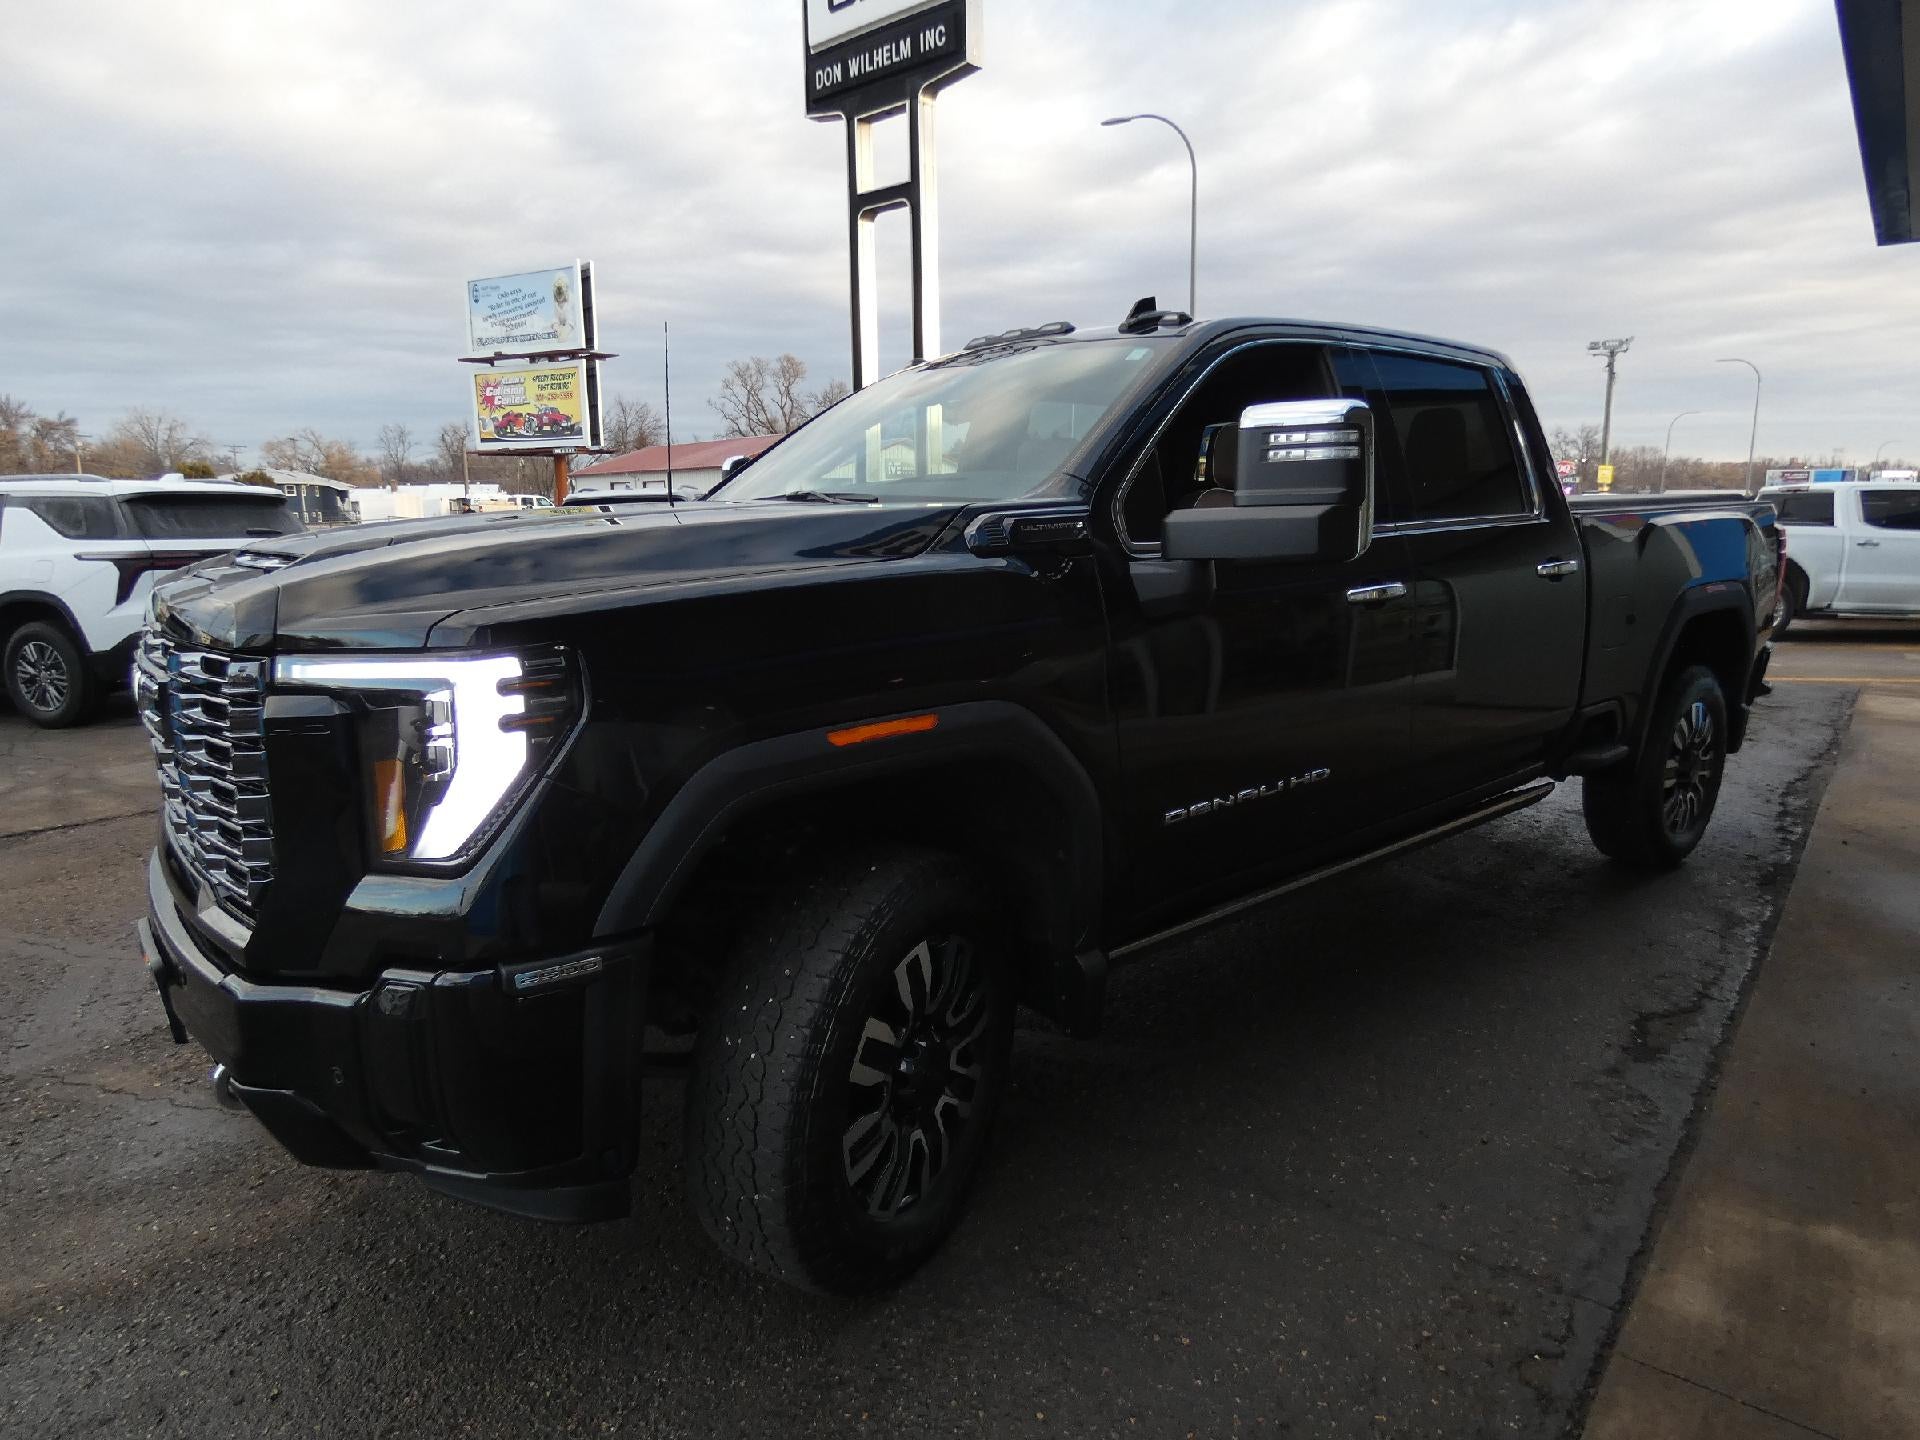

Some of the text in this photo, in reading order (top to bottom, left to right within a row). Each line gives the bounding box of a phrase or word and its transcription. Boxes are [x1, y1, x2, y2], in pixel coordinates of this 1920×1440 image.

[815, 25, 947, 90] DON WILHELM INC
[494, 396, 526, 406] Center
[537, 383, 550, 391] FAST
[1164, 767, 1331, 825] DENALI HD
